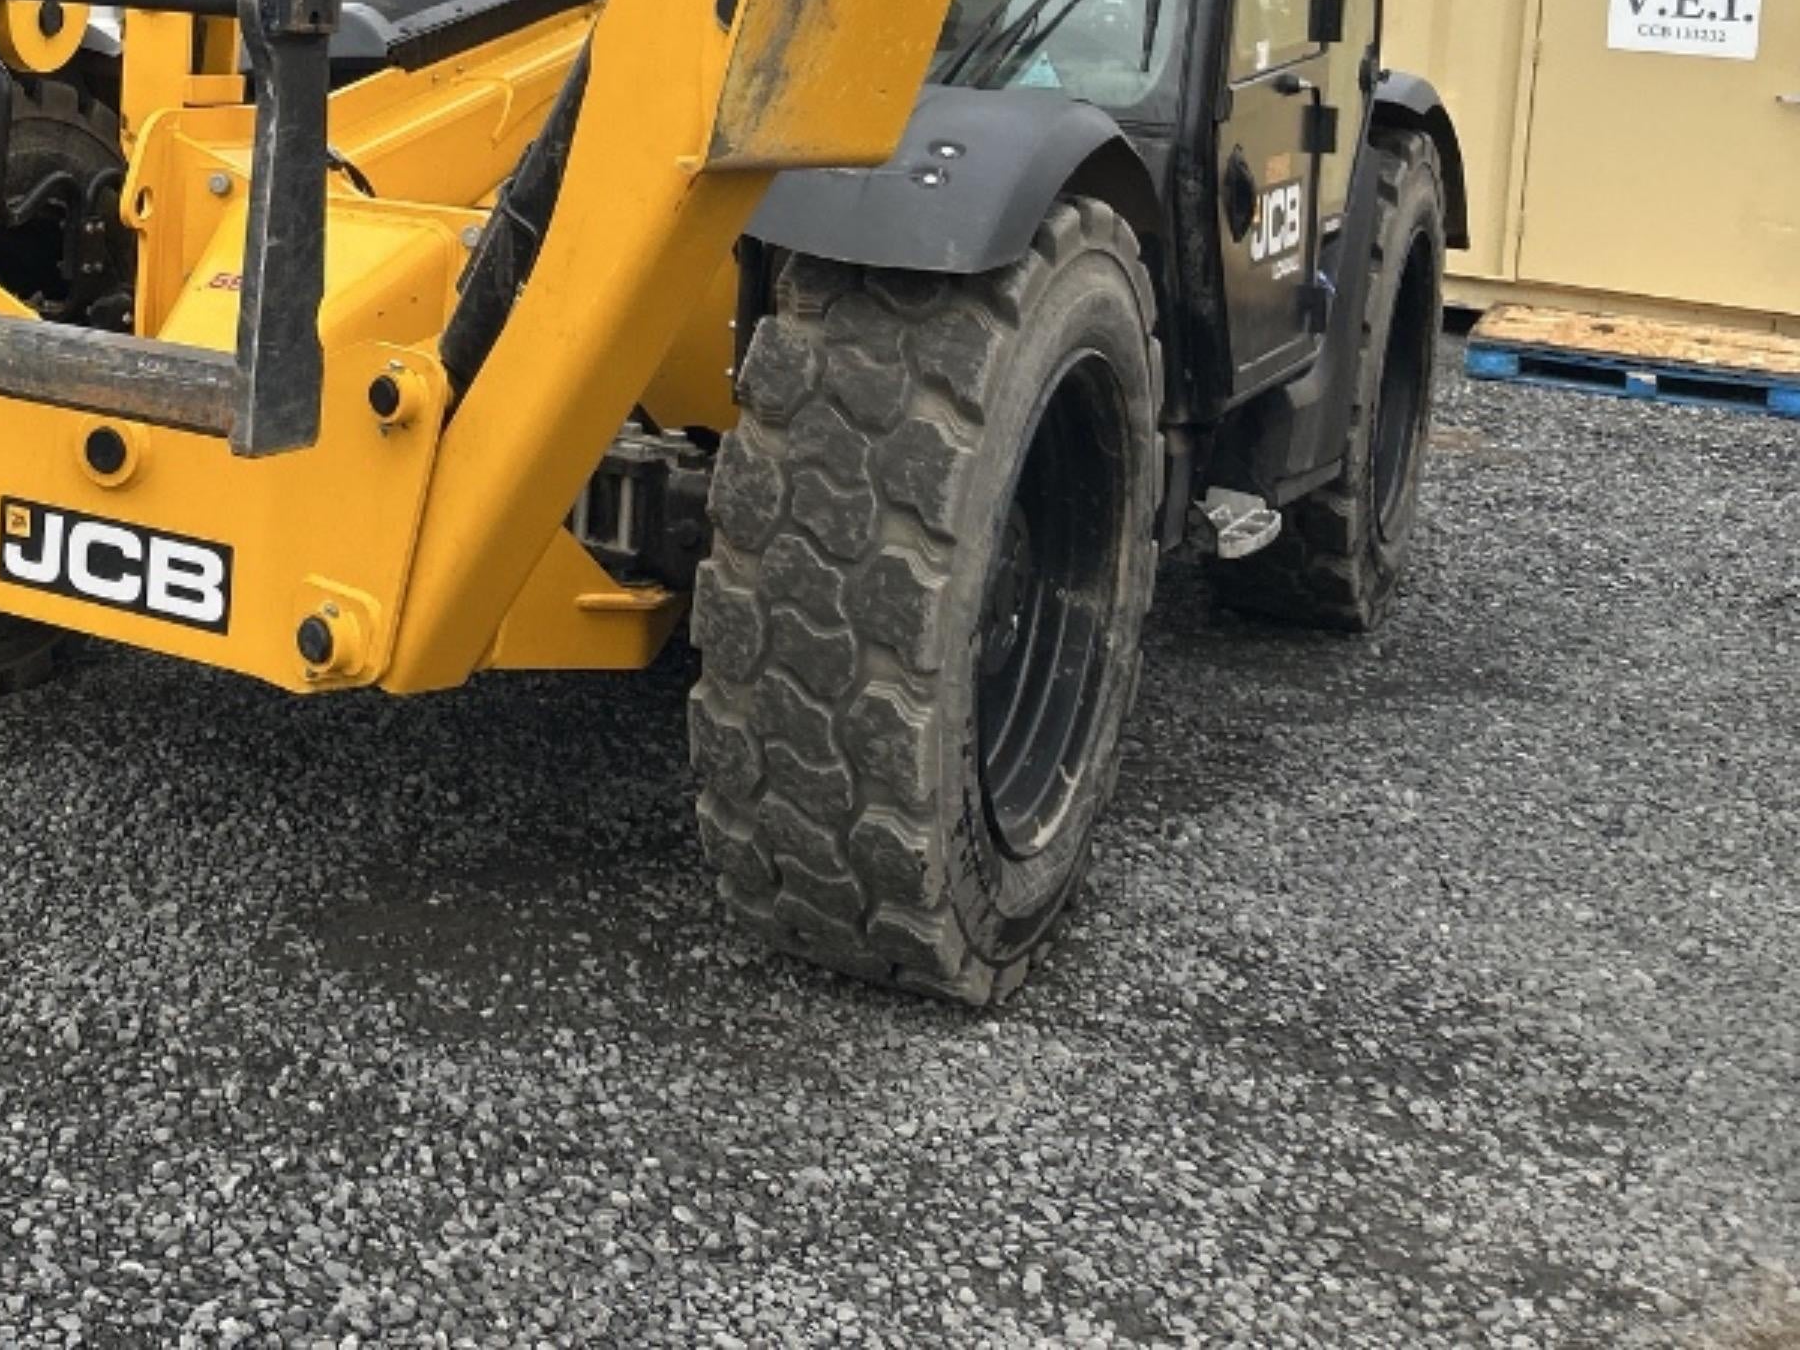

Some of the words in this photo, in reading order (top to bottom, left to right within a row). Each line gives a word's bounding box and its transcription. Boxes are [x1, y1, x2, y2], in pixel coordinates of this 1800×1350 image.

[1637, 23, 1672, 38] CCB
[1250, 183, 1300, 262] JCB
[3, 511, 225, 623] JCB
